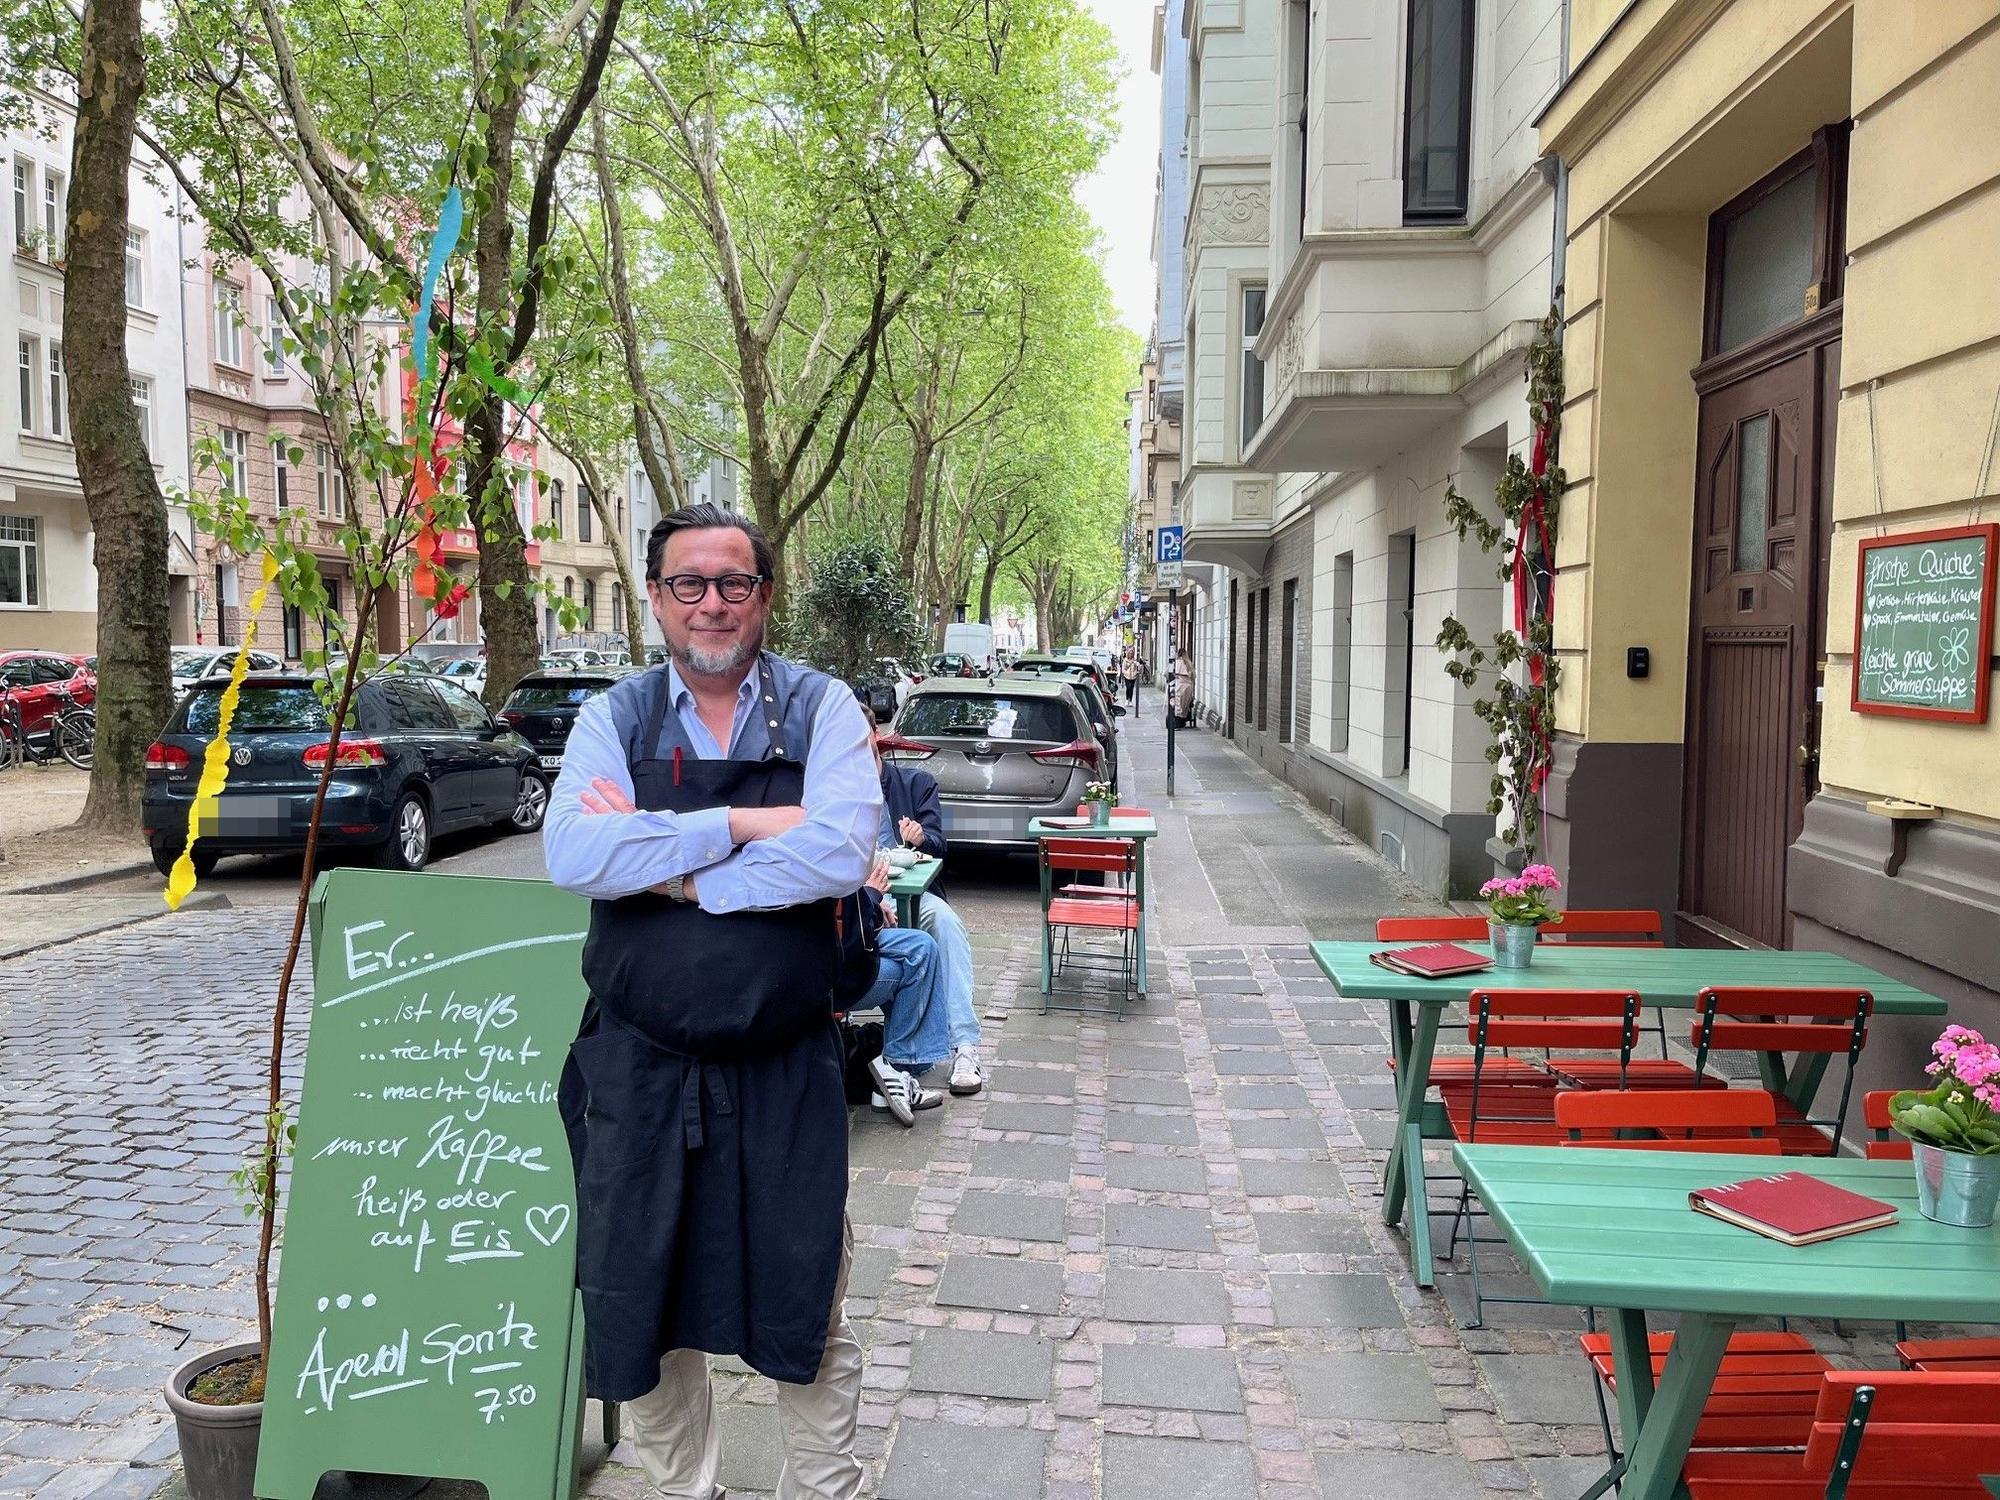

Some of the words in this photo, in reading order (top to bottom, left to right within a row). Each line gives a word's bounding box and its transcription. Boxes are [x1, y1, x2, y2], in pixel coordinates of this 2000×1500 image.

[1161, 531, 1175, 561] P
[1866, 555, 1910, 596] frische
[1919, 549, 1975, 577] Quiche
[1863, 645, 1899, 672] leichte
[1902, 649, 1939, 679] grüne
[1880, 672, 1968, 704] Sommersuppe
[441, 990, 518, 1042] heiß
[466, 1036, 541, 1082] gut
[383, 1077, 470, 1101] macht
[312, 1136, 409, 1160] unser
[416, 1115, 551, 1185] Kaffee
[352, 1176, 427, 1228] heiß
[436, 1189, 517, 1210] oder
[371, 1218, 436, 1273] auf
[450, 1220, 512, 1250] Eis
[296, 1327, 410, 1411] Aperol
[420, 1301, 539, 1385] Spritz
